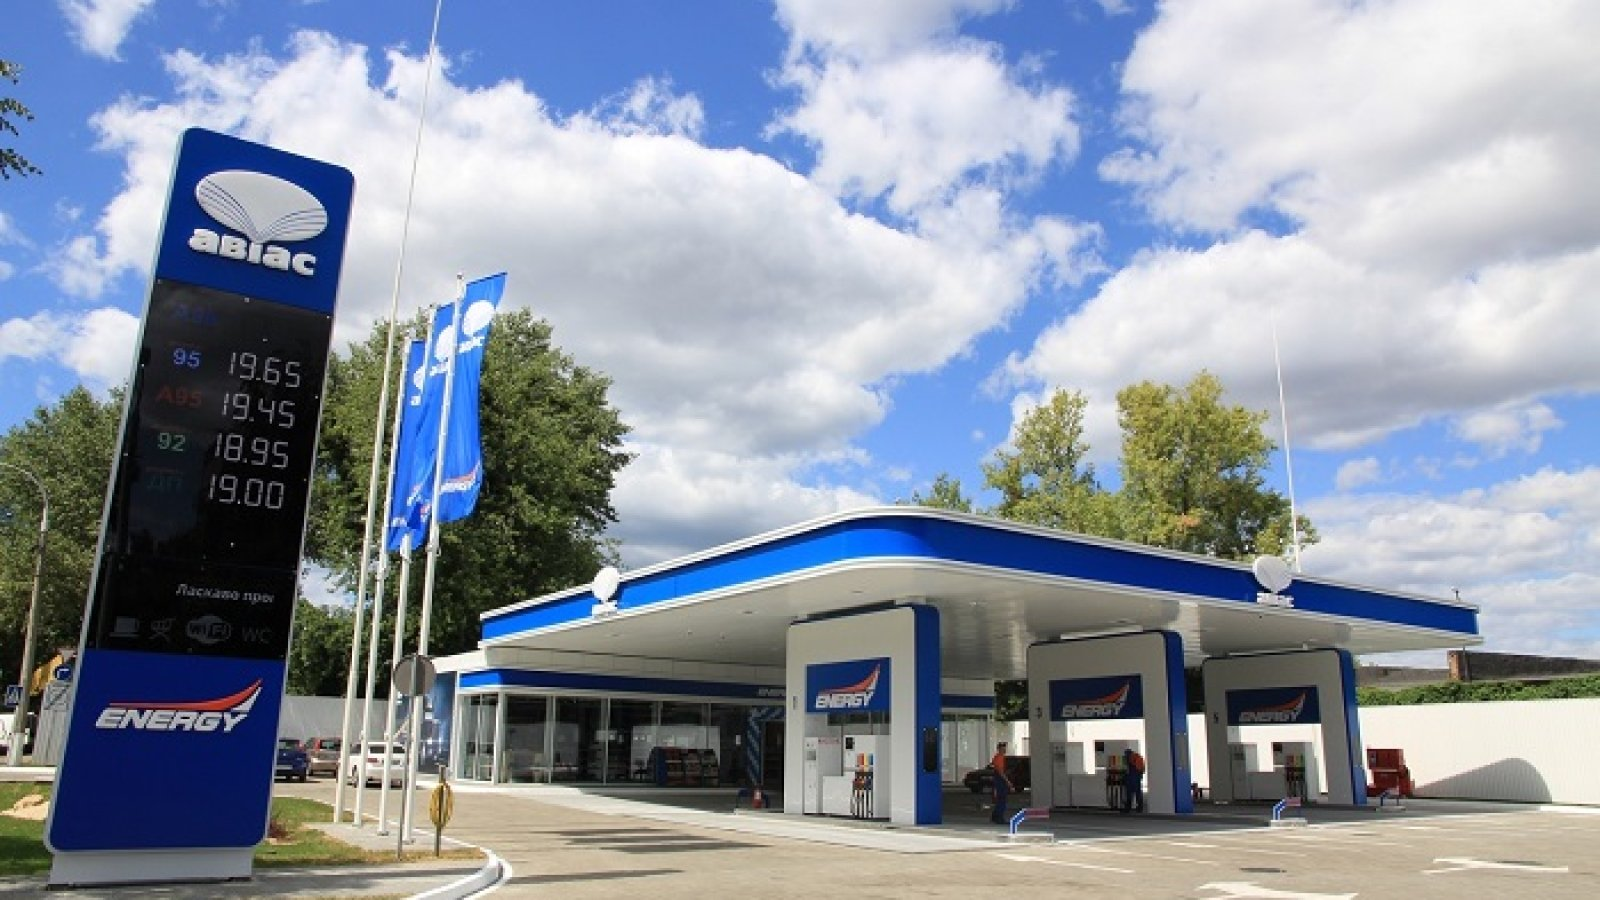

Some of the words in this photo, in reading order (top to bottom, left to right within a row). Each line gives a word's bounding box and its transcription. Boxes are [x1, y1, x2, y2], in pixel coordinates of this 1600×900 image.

[172, 347, 202, 369] 95
[228, 351, 301, 389] 19.65
[221, 390, 296, 429] 19.45
[157, 432, 186, 452] 92
[214, 432, 289, 469] 18.95
[208, 473, 285, 510] 19.00
[241, 626, 272, 645] WC
[815, 690, 875, 709] ENERGY
[95, 706, 248, 733] ENERGY
[1238, 709, 1301, 723] ENERGY
